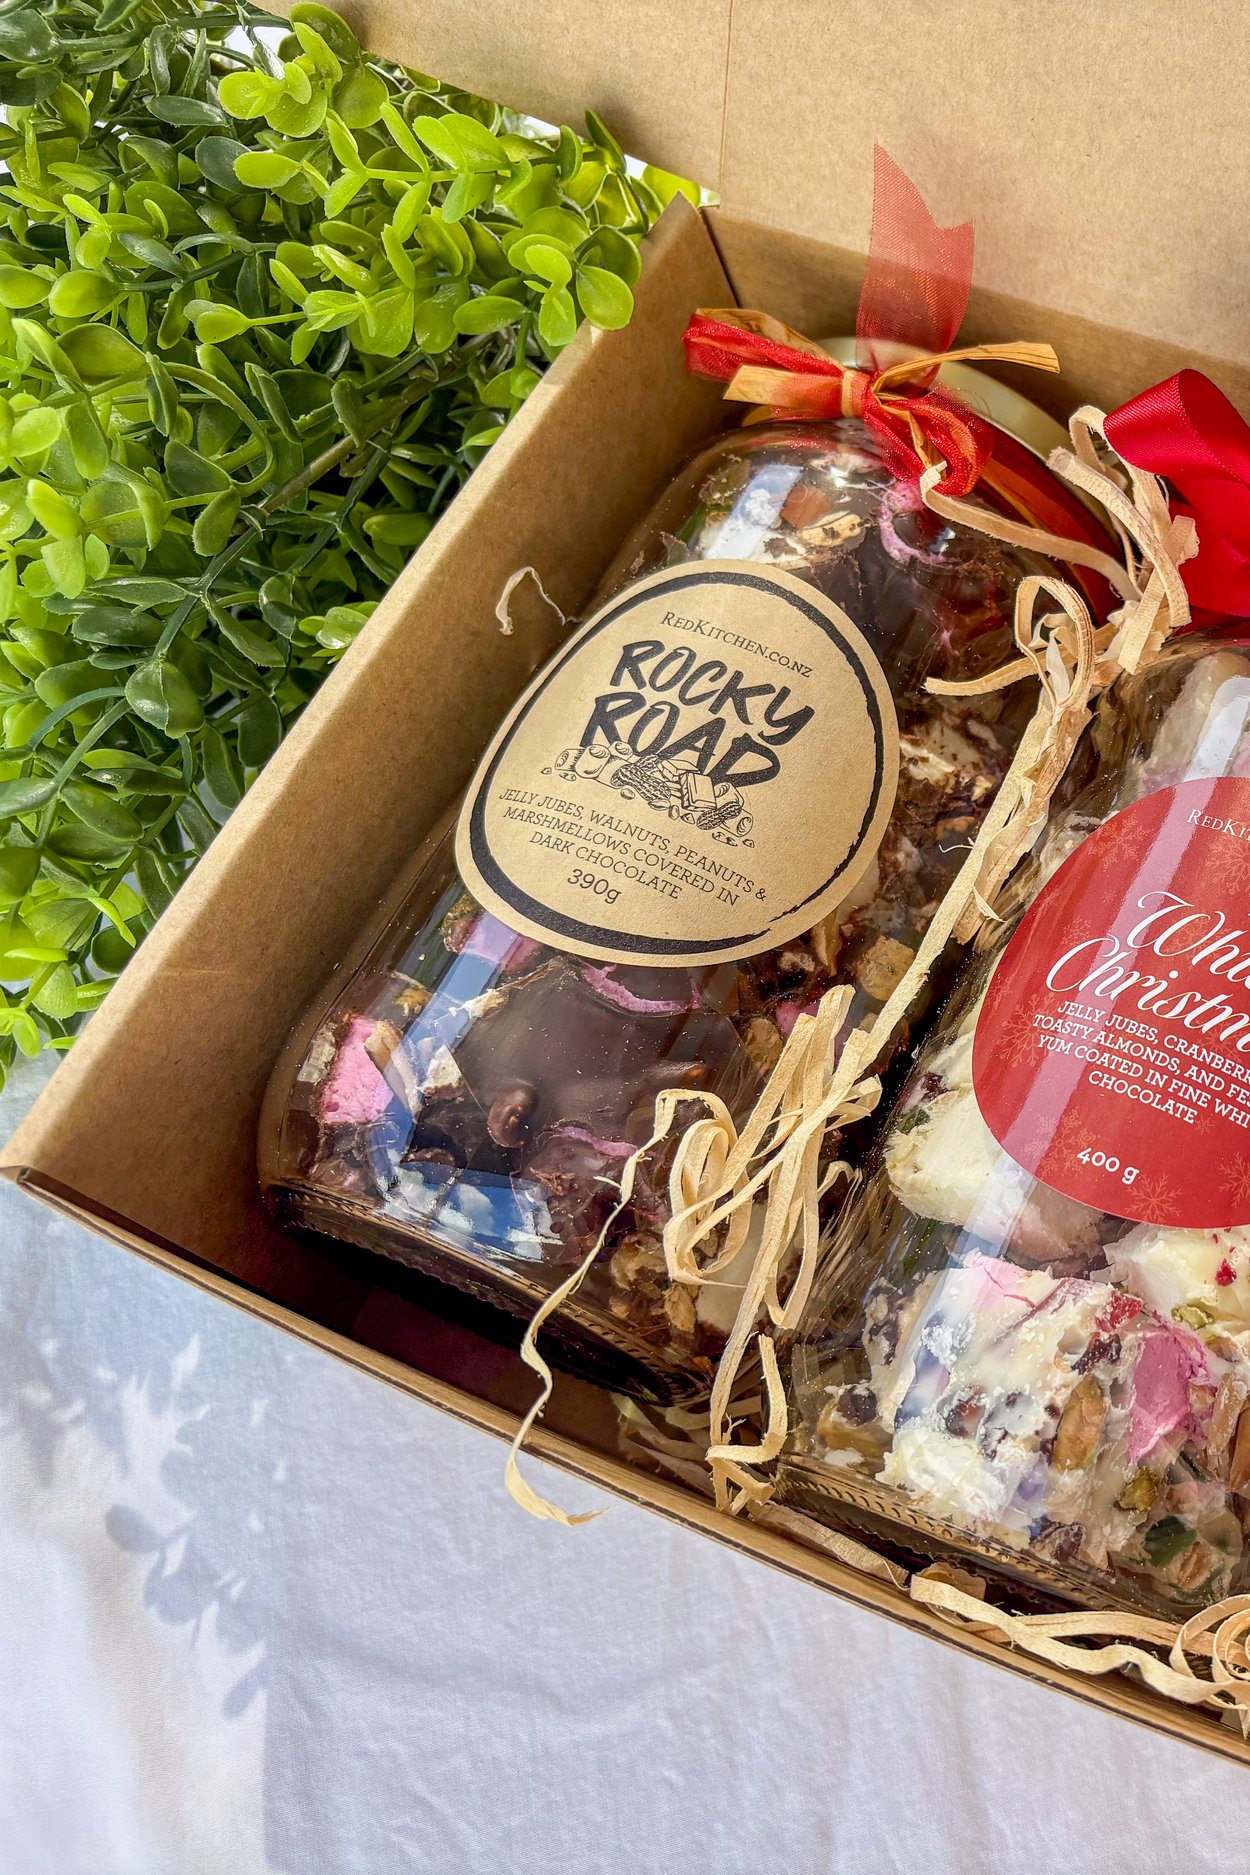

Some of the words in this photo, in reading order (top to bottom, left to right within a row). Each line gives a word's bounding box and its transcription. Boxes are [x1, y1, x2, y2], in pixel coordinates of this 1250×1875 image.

[609, 640, 815, 746] ROCKY
[579, 691, 781, 788] ROAD
[499, 789, 536, 804] JELLY
[538, 796, 584, 821] JUBES,
[590, 810, 671, 854] WALNUTS,
[674, 845, 754, 893] PEANUTS
[755, 888, 767, 901] &
[503, 807, 631, 855] MARSHMELLOWS
[633, 849, 715, 893] COVERED
[717, 887, 740, 906] IN
[529, 831, 575, 855] DARK
[576, 846, 683, 899] CHOCOLATE
[567, 869, 621, 905] 390g
[1032, 1014, 1094, 1040] TOASTY
[1093, 1030, 1181, 1074] ALMONDS,
[1184, 1065, 1225, 1092] AND
[1058, 1001, 1106, 1023] JELLY
[1105, 1014, 1159, 1044] JUBES,
[1038, 1035, 1075, 1055] YUM
[1074, 1046, 1143, 1078] COATED
[1145, 1069, 1168, 1088] IN
[1168, 1078, 1211, 1108] FINE
[1088, 1071, 1198, 1124] CHOCOLATE
[1077, 1147, 1120, 1173] 400
[1121, 1166, 1140, 1185] g
